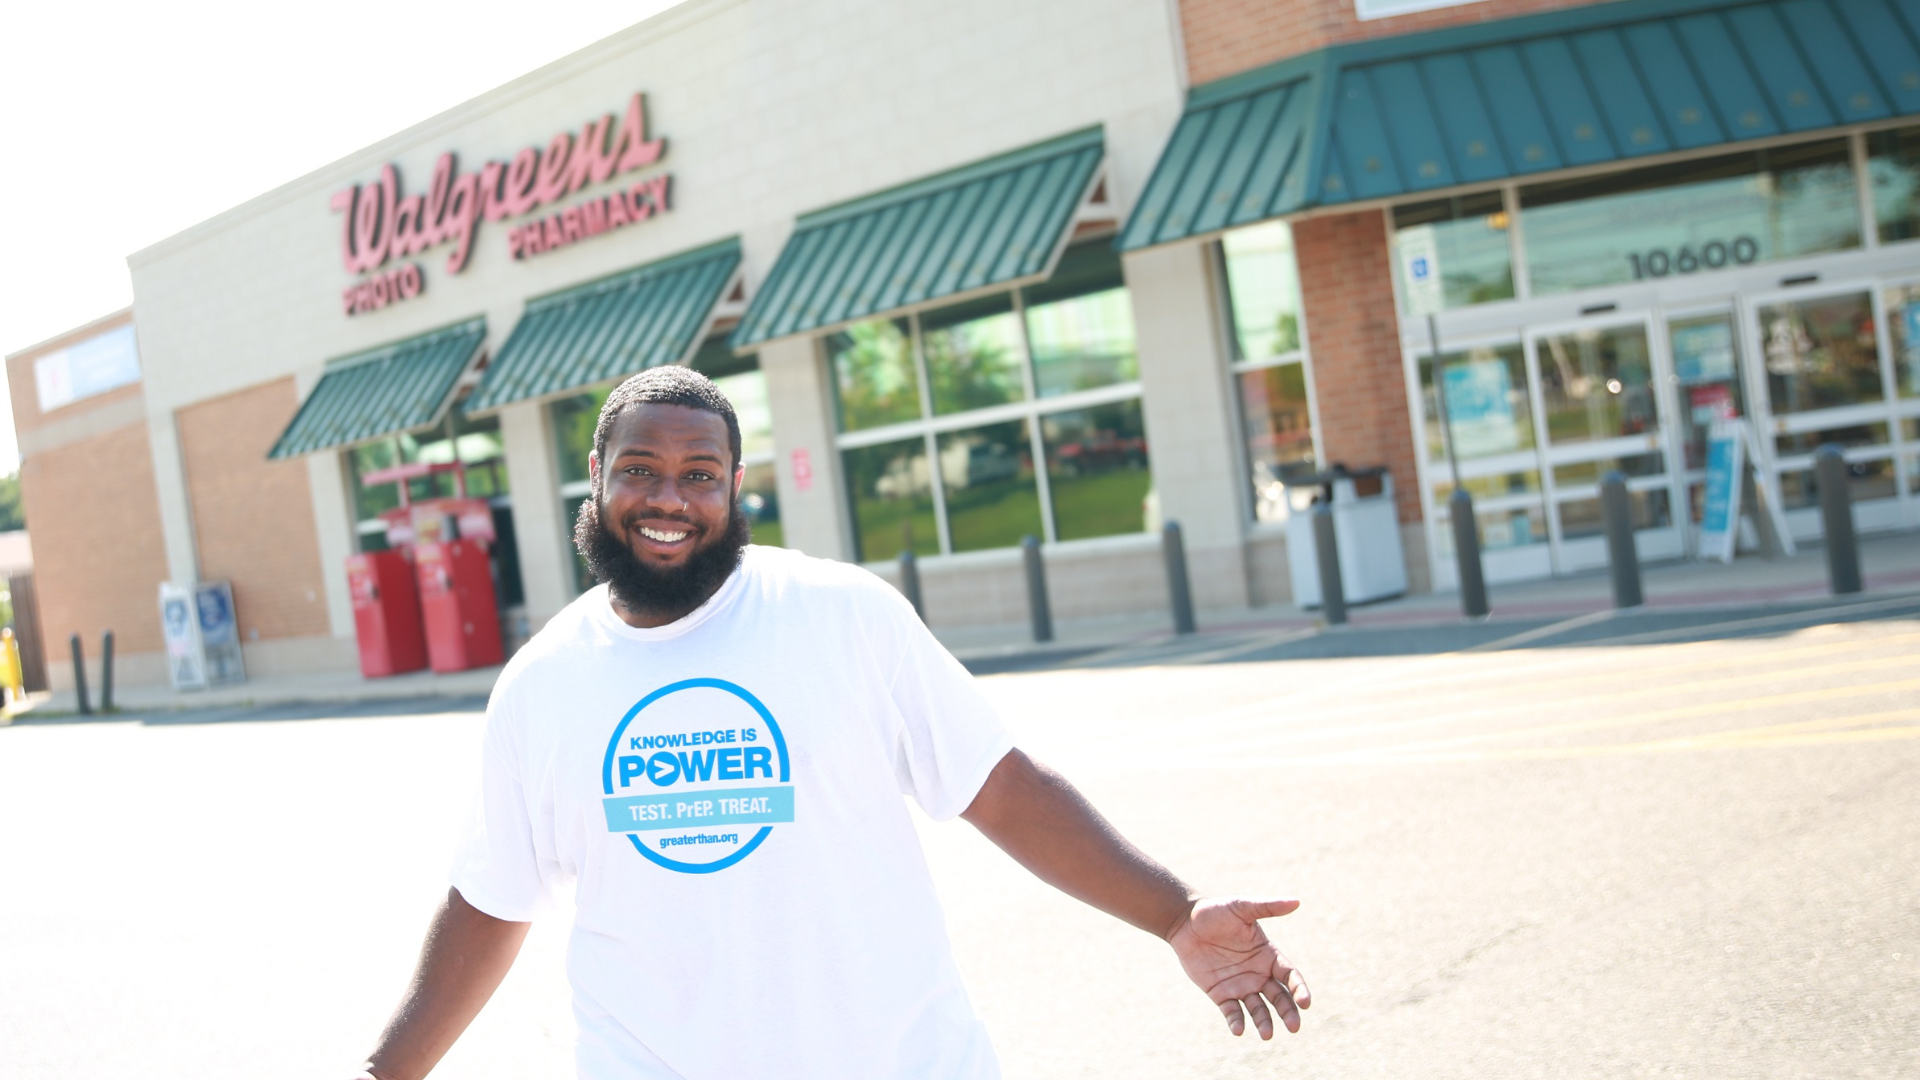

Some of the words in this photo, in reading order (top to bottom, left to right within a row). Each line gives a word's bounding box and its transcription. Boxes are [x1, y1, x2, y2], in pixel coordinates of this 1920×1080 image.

[331, 92, 667, 275] Walgreens
[507, 173, 674, 261] PHARMACY
[1628, 235, 1758, 279] 10600
[342, 262, 424, 315] PHOTO
[630, 729, 736, 750] KNOWLEDGE
[741, 728, 757, 742] IS
[618, 746, 773, 788] POWER
[629, 803, 672, 821] TEST.
[676, 800, 713, 818] PrEP.
[718, 797, 772, 815] TREAT.
[659, 833, 738, 849] greaterthan.org
